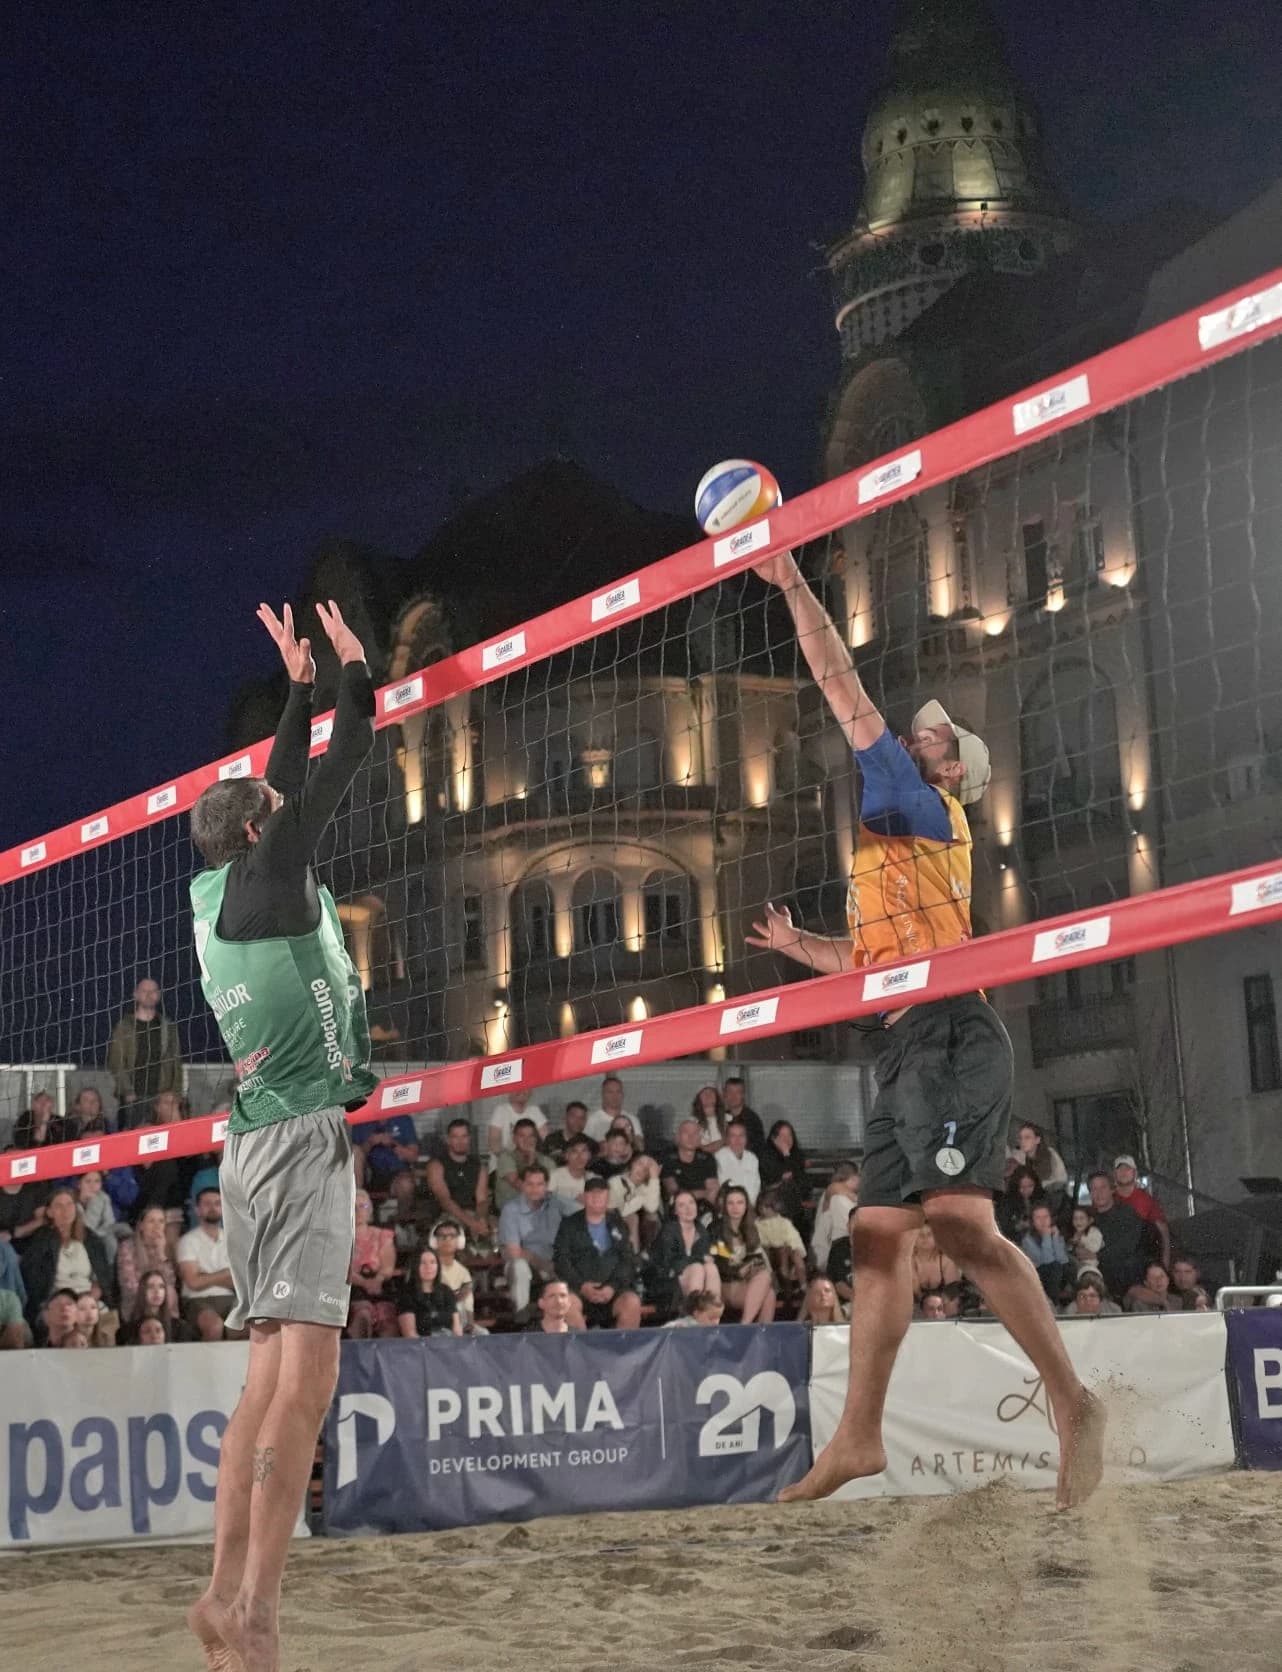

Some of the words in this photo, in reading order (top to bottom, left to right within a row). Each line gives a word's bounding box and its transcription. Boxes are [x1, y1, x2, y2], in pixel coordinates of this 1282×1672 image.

[427, 1380, 625, 1441] PRIMA
[429, 1451, 562, 1475] DEVELOPMENT
[568, 1447, 629, 1465] GROUP
